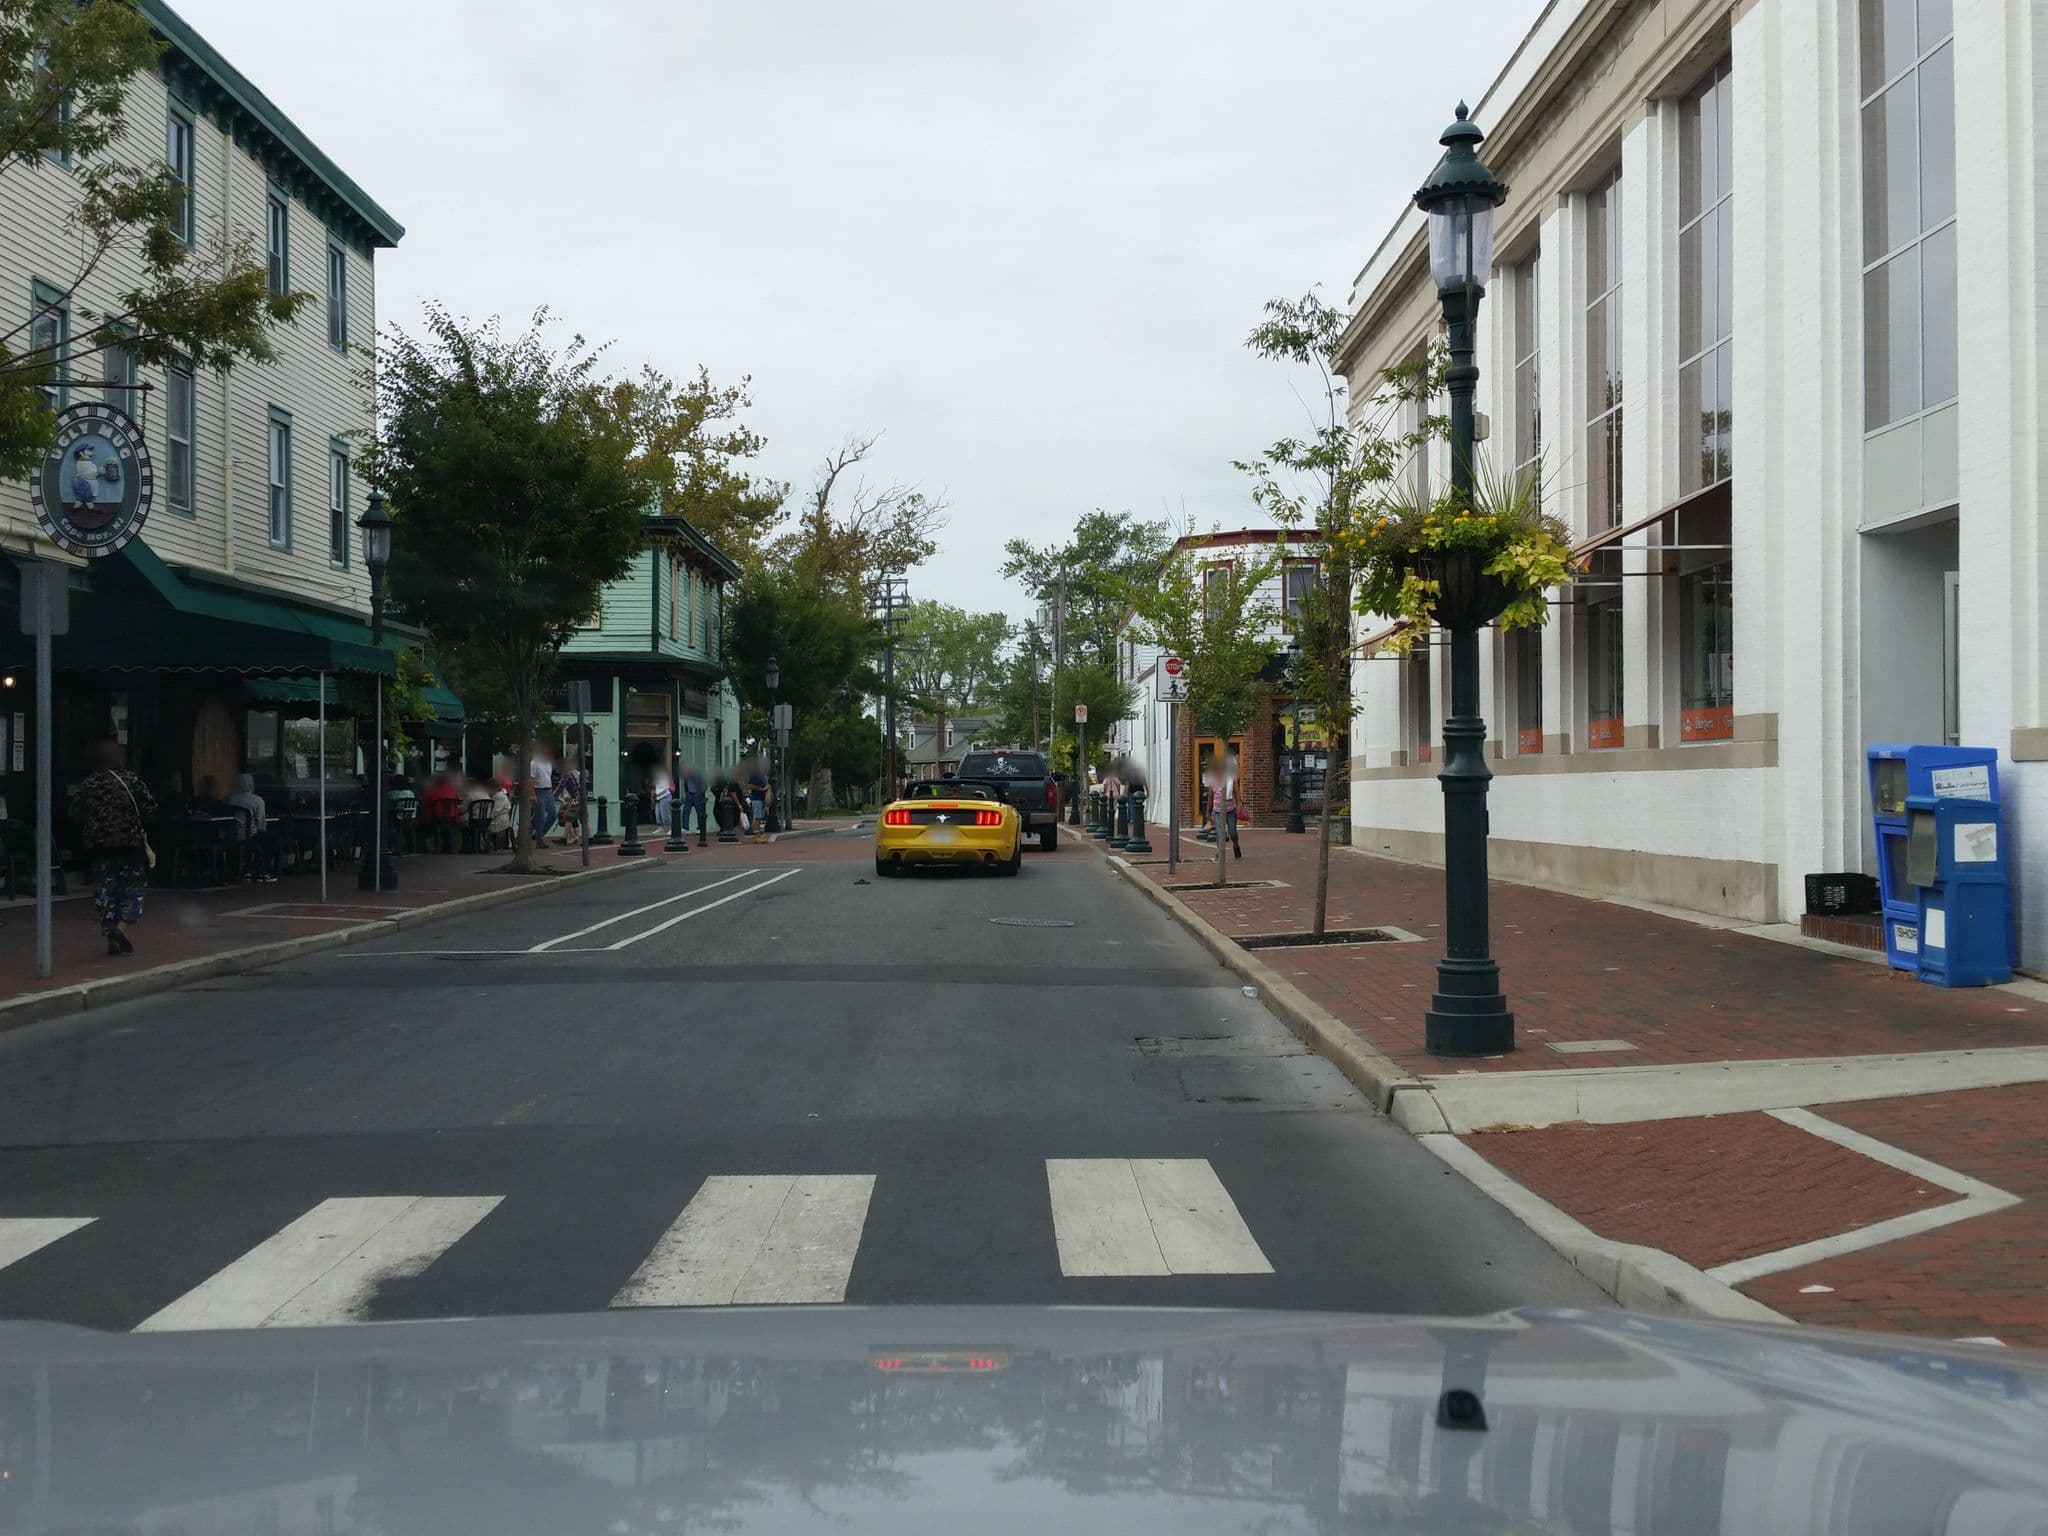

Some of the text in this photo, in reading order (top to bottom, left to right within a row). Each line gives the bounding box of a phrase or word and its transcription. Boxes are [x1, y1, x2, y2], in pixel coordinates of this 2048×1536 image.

[50, 421, 131, 460] UGLY MUG
[60, 518, 83, 539] Cape
[112, 517, 124, 530] NJ
